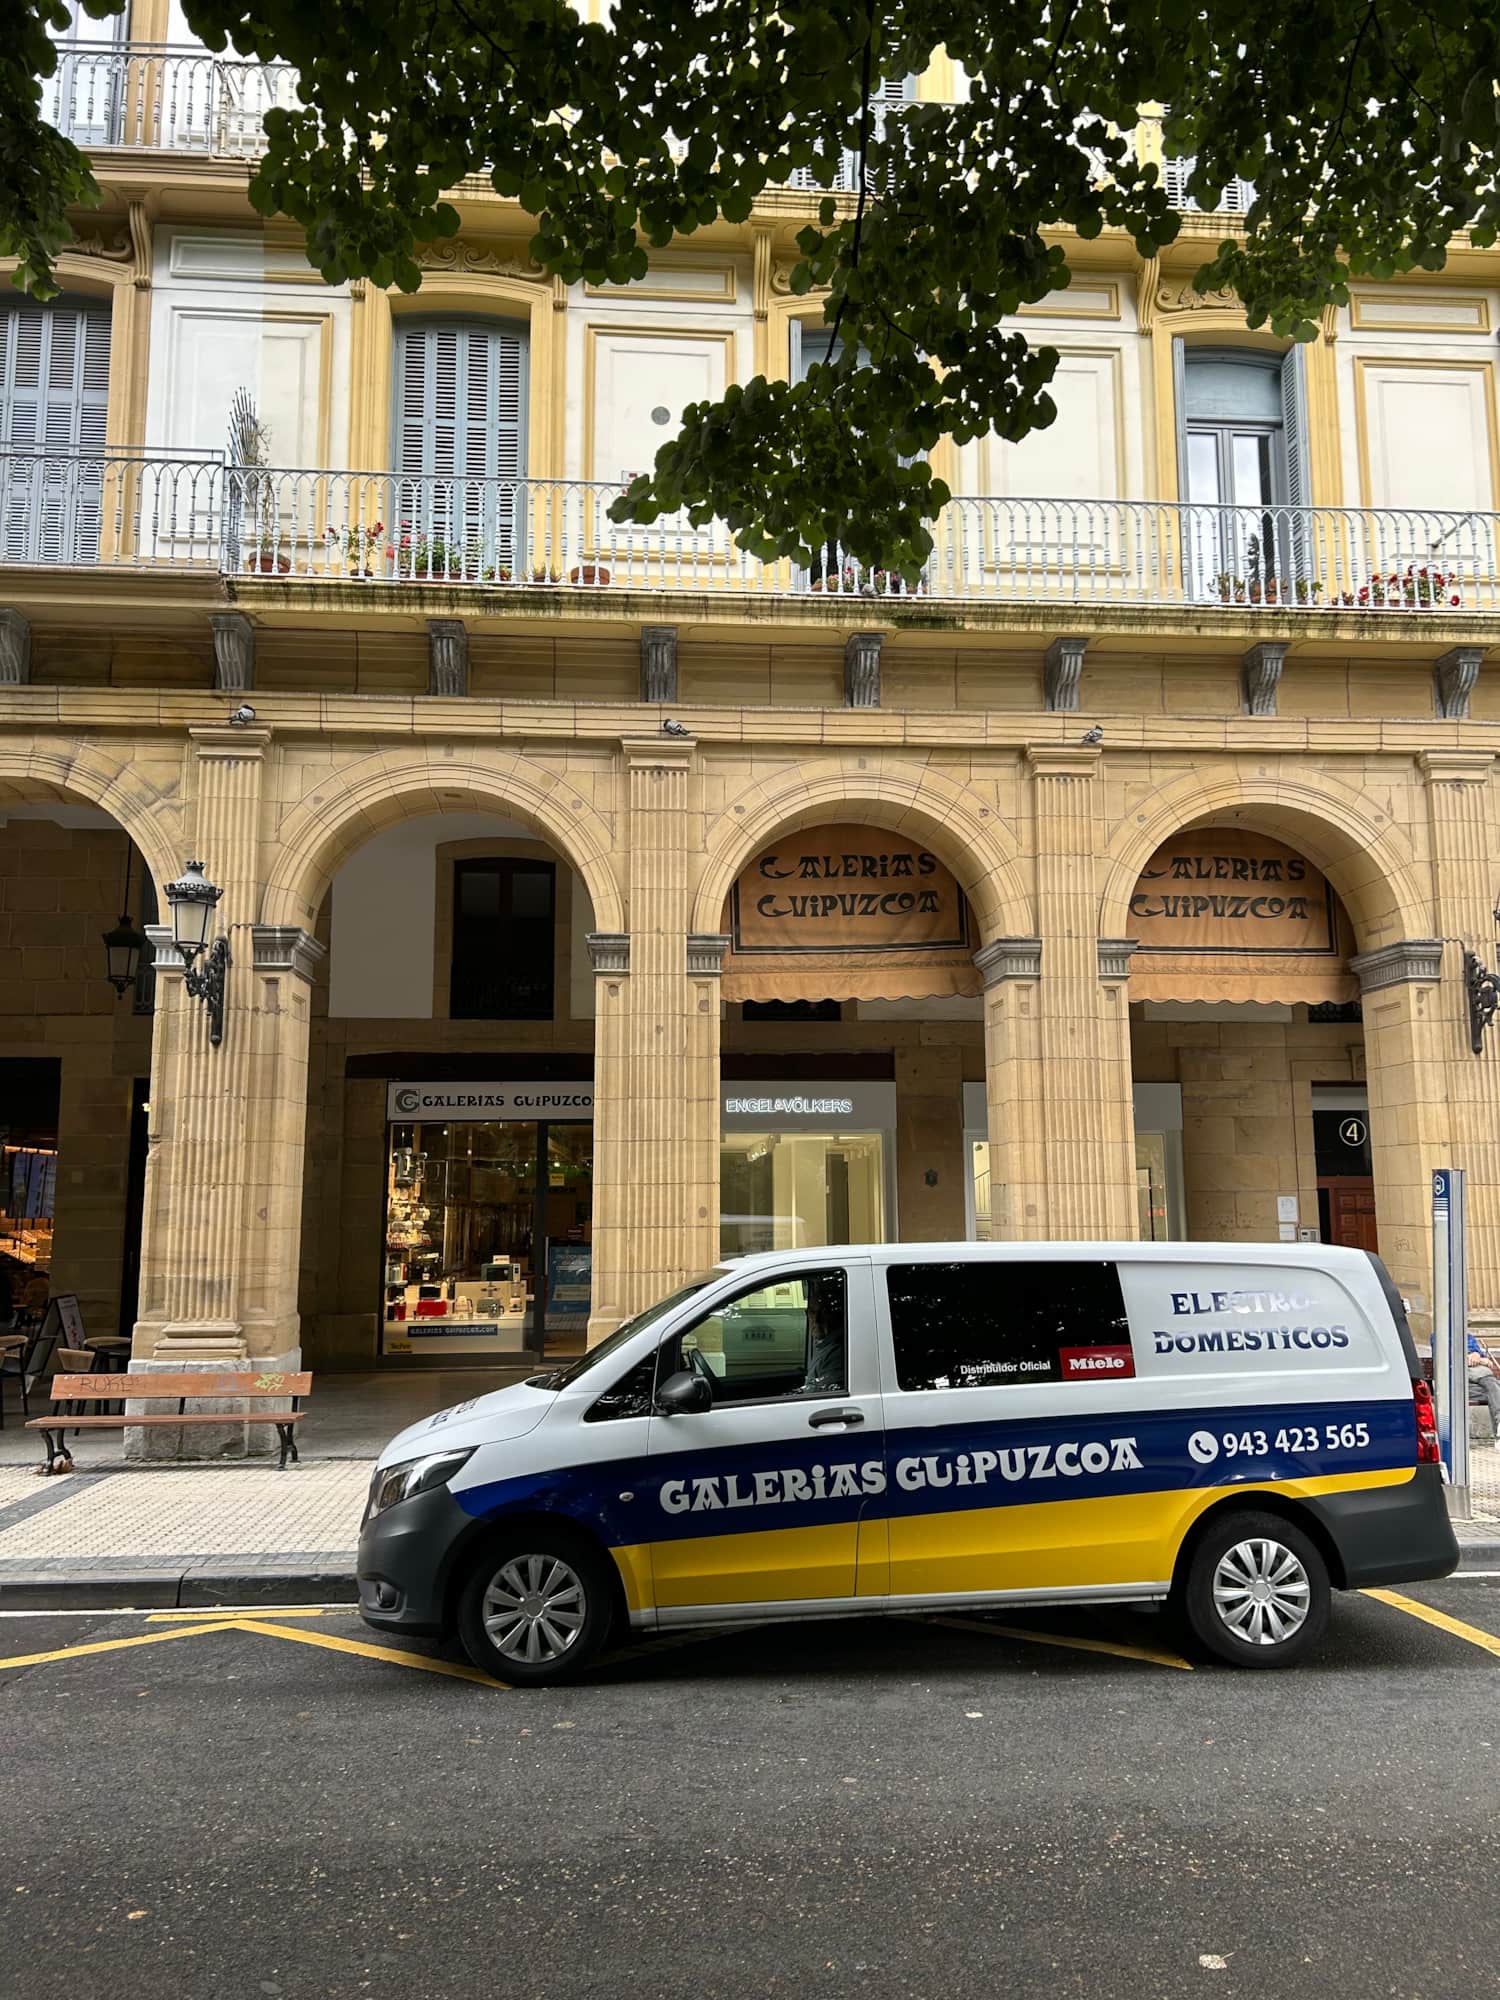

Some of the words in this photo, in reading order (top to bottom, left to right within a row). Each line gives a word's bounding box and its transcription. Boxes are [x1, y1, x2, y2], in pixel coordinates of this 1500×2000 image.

[1346, 1122, 1359, 1142] 4
[1019, 1360, 1051, 1372] Oficial
[1068, 1357, 1125, 1370] Miele
[1223, 1431, 1269, 1458] 943
[1274, 1427, 1320, 1453] 423
[1326, 1423, 1370, 1450] 565
